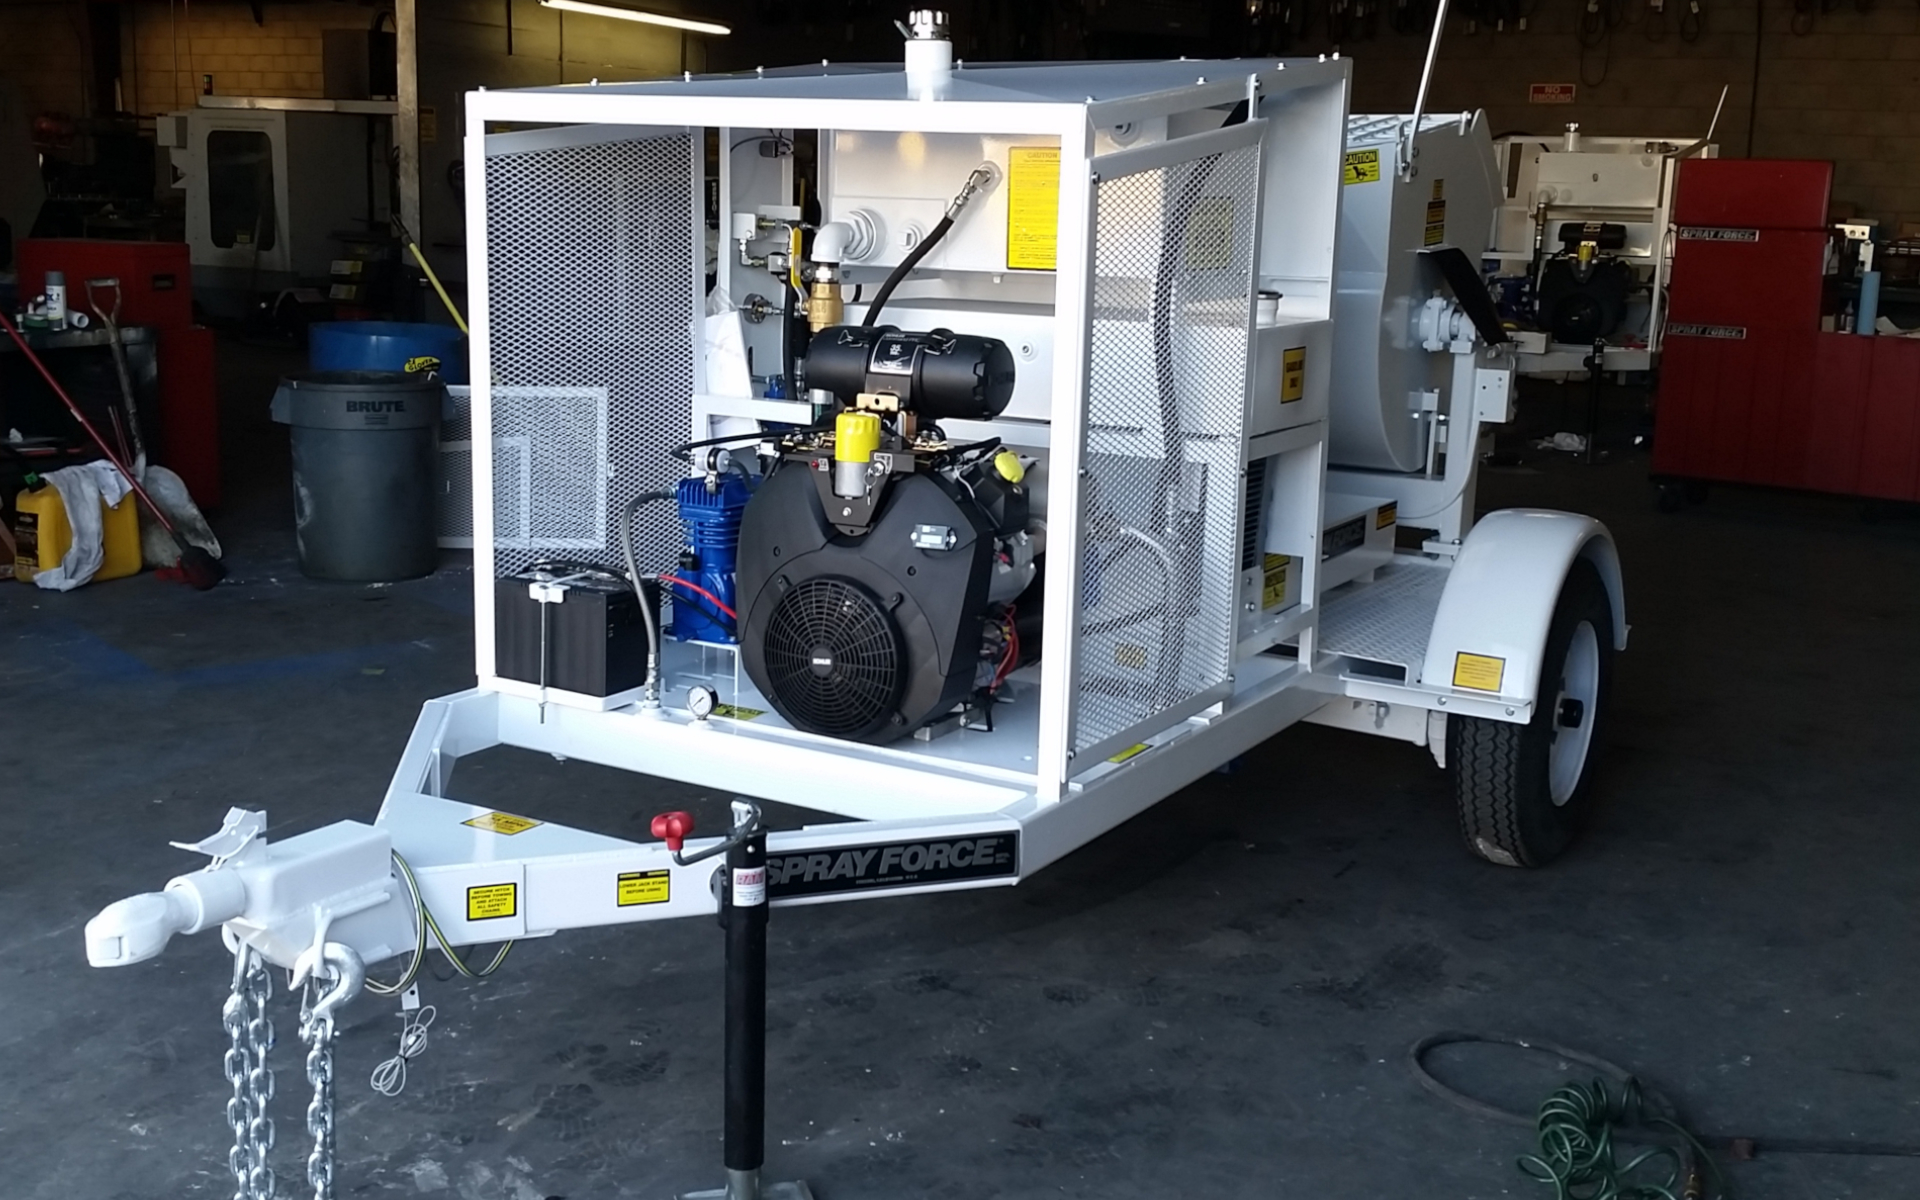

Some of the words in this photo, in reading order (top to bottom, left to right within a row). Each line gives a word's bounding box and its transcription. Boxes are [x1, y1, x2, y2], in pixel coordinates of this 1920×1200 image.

[1545, 86, 1561, 94] NO
[1533, 94, 1572, 102] SMOKING
[1345, 151, 1377, 166] CAUTION
[1682, 229, 1716, 239] SPRAY
[1717, 231, 1752, 240] FORCE
[1671, 325, 1704, 335] SPRAY
[1705, 328, 1738, 338] FORCE
[346, 401, 406, 412] BRUTE
[766, 848, 873, 886] SPRAY
[878, 838, 998, 875] FORCE
